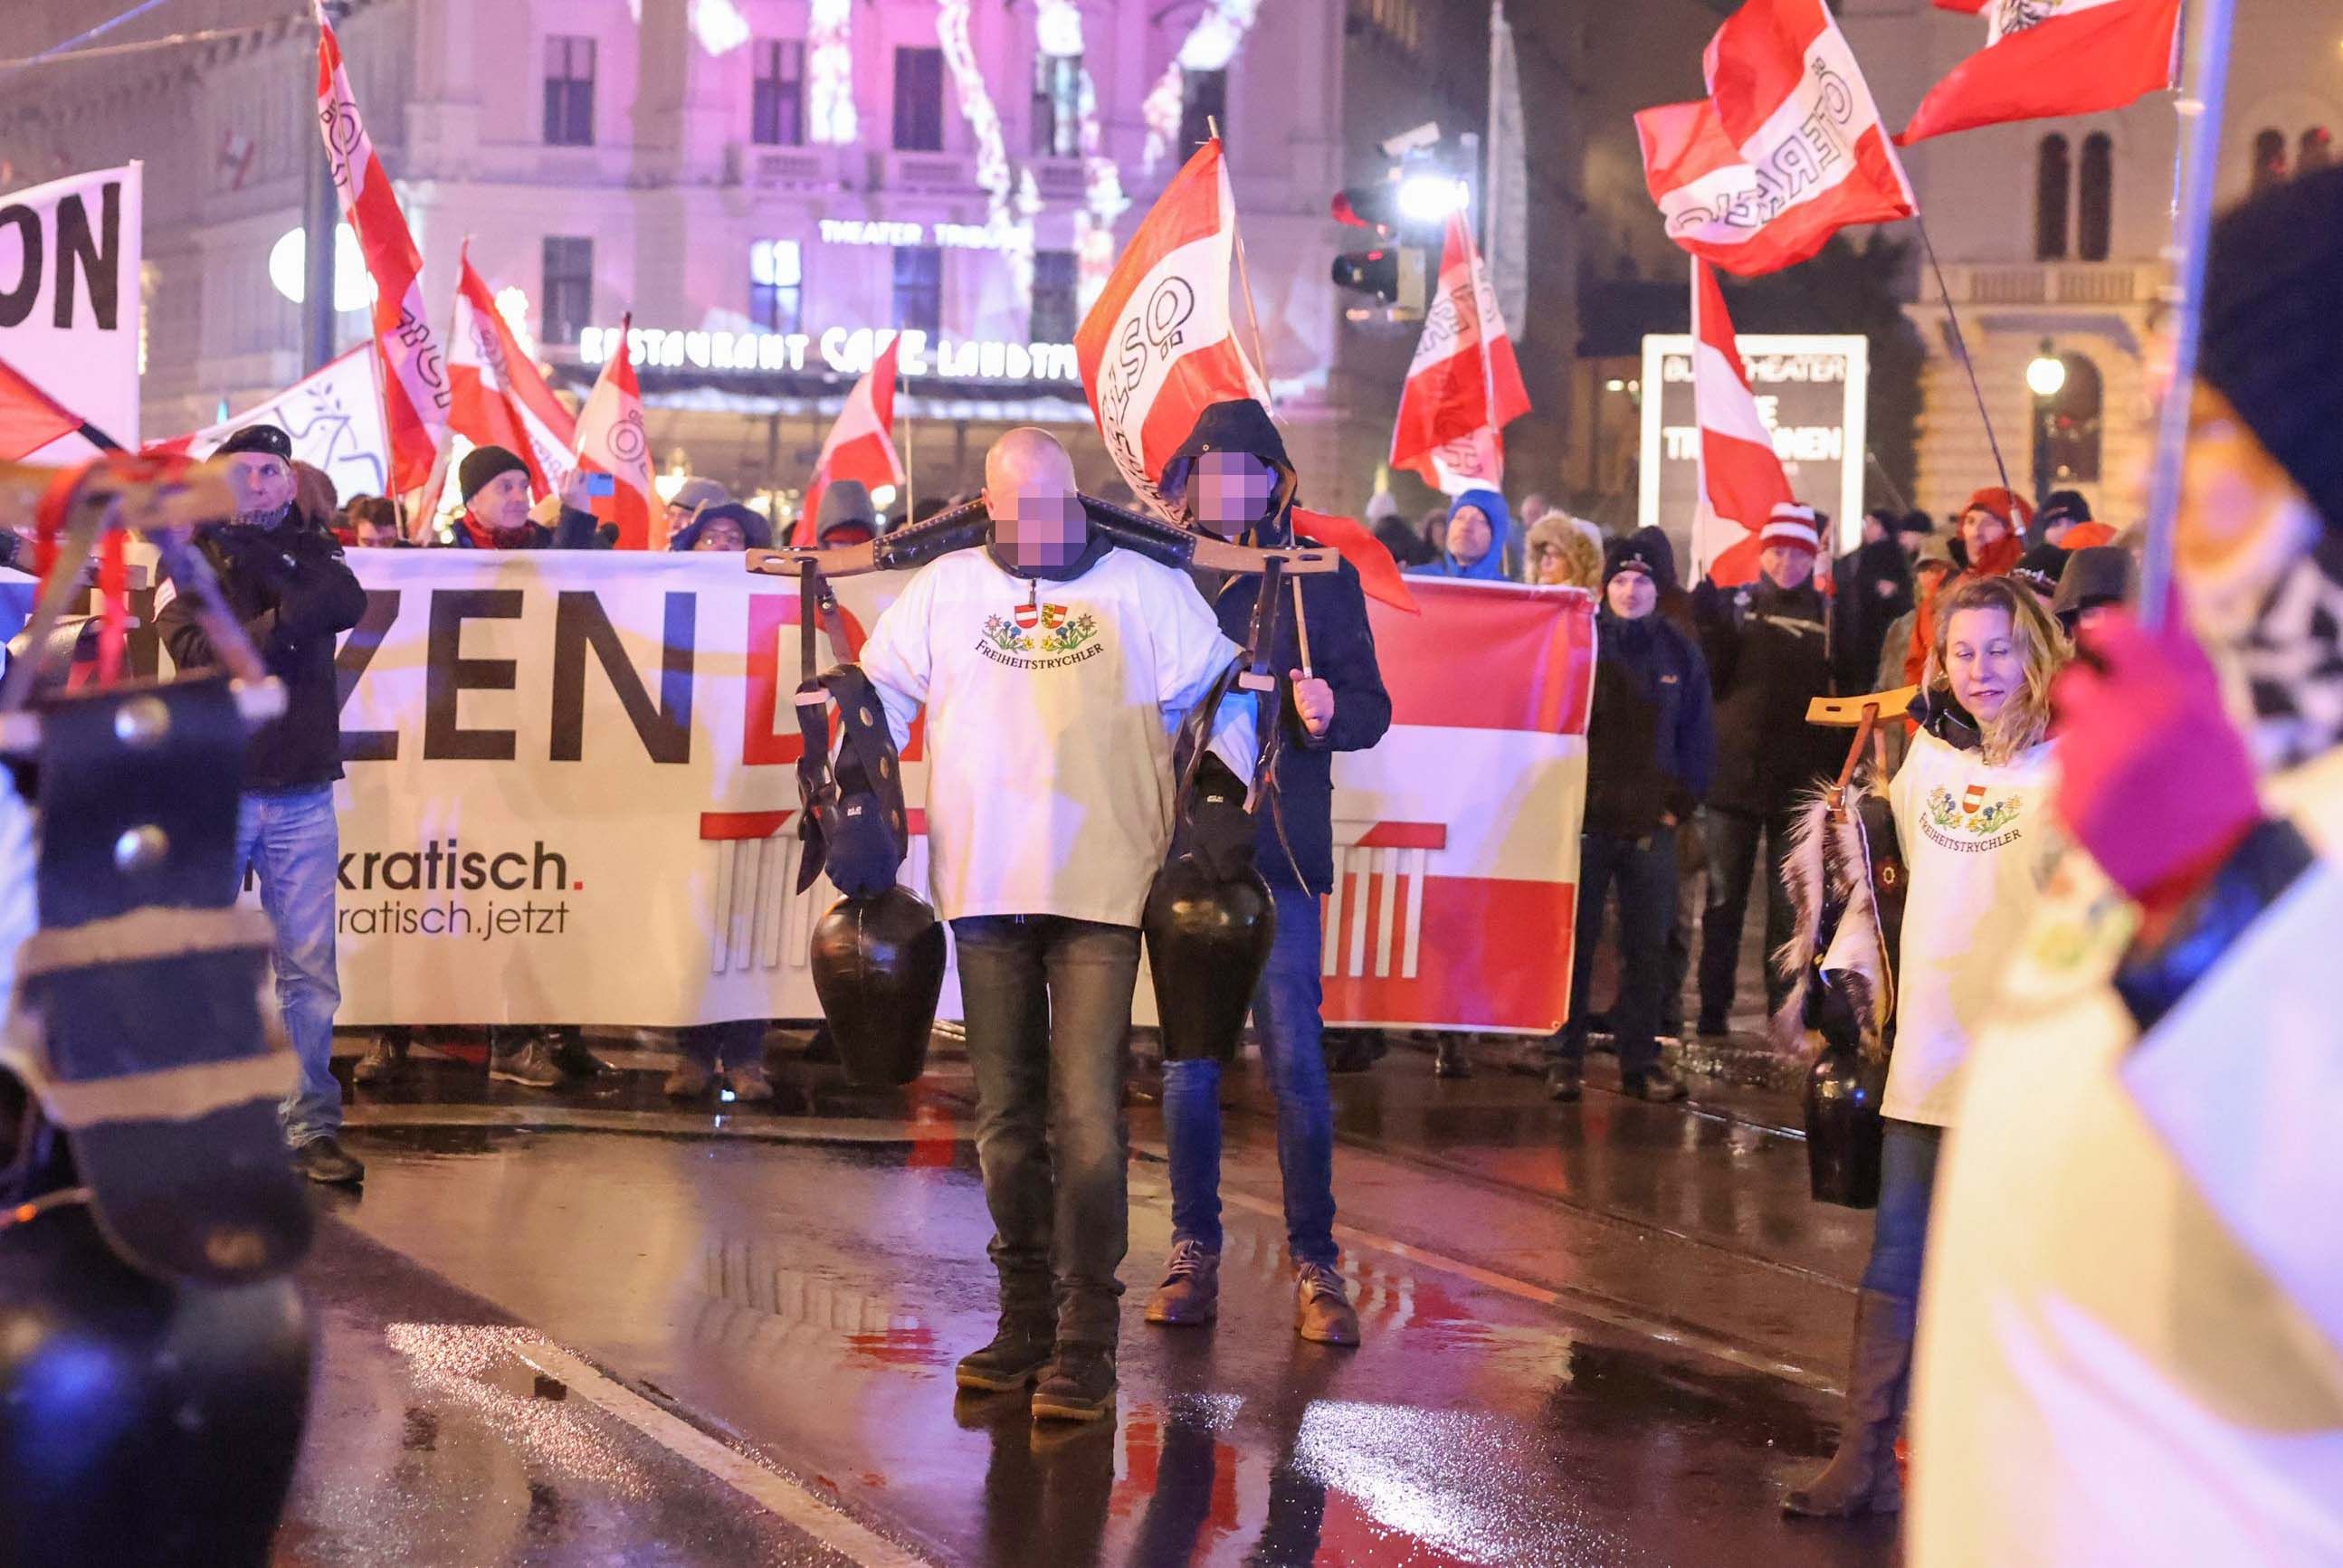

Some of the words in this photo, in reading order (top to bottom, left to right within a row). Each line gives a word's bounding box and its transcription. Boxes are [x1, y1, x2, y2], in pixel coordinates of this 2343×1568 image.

[975, 639, 1104, 670] FREIHEITSTRYCHLER
[338, 589, 697, 765] ZEN
[1919, 812, 2022, 852] FREIHEITSTRYCHLER
[337, 840, 584, 891] kratisch.
[338, 900, 570, 941] ratisch.jetzt
